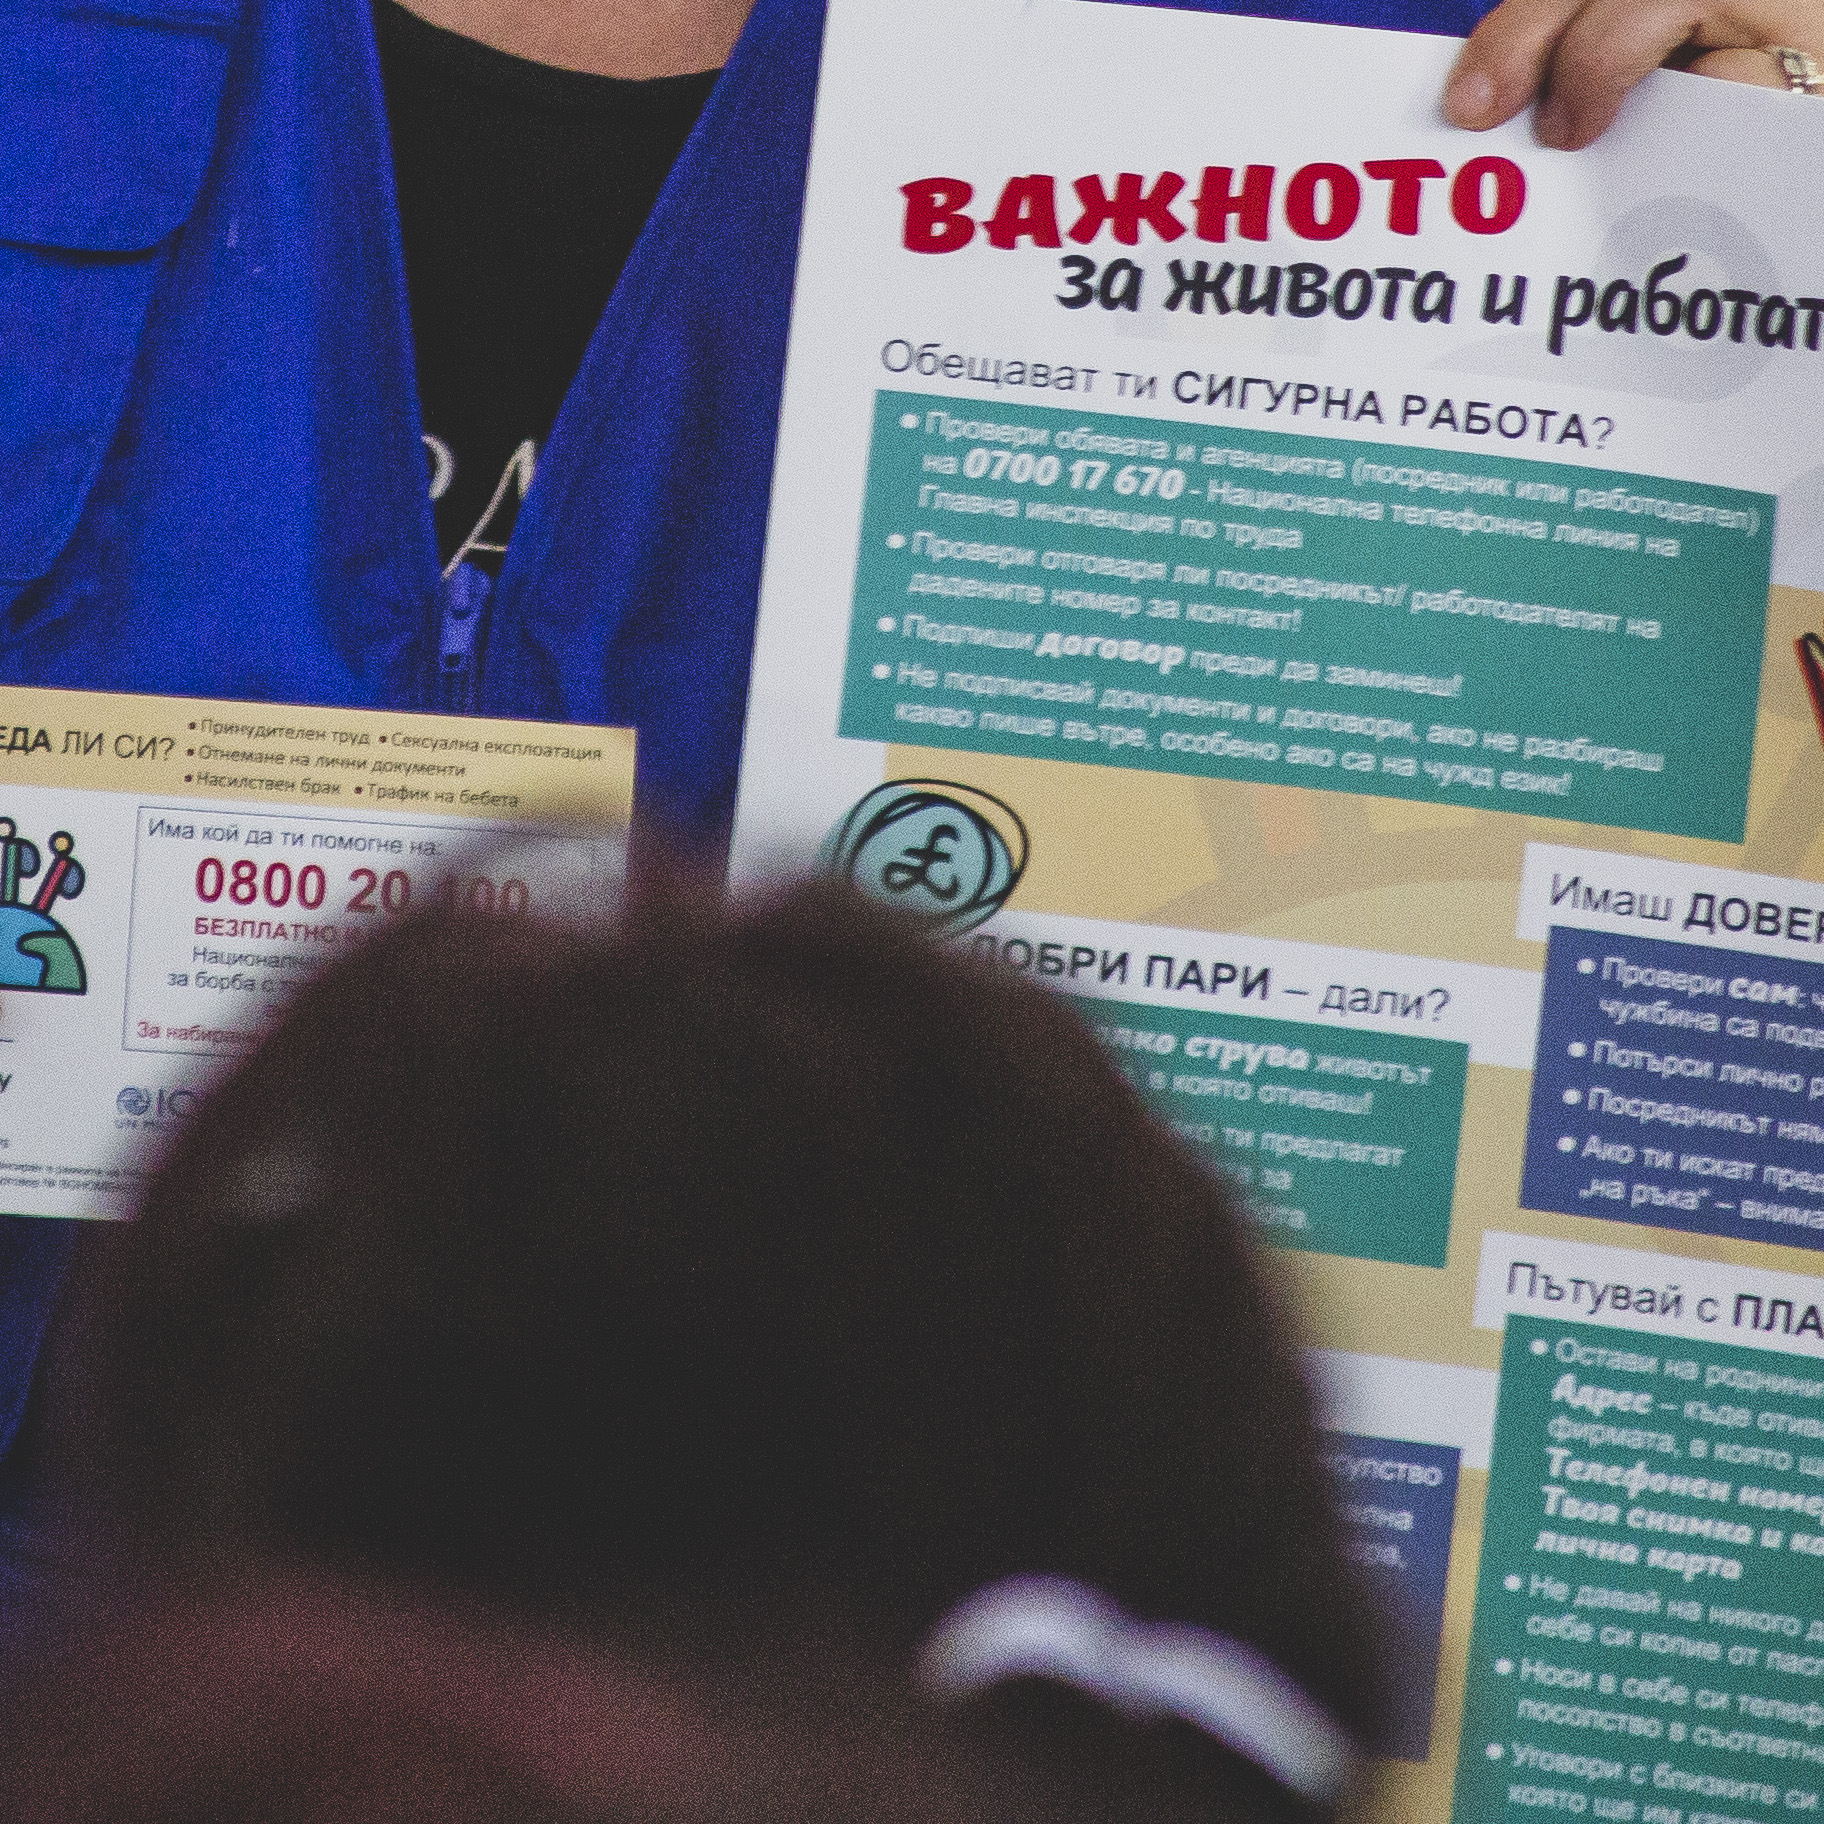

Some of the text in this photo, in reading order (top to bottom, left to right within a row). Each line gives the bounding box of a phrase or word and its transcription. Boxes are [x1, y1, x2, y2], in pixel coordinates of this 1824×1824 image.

[900, 155, 1526, 254] ВАЖНОТО
[1057, 254, 1142, 311] за
[1164, 259, 1456, 324] живота
[1480, 272, 1525, 327] и
[882, 338, 1613, 447] Обещават ти СИГУРНА РАБОТА?
[922, 446, 1680, 557] на 0700 17 670 Национална телефонна линия на
[925, 410, 1049, 447] Провери
[1054, 426, 1169, 459] обявата
[1201, 445, 1345, 478] агенцията
[1351, 457, 1509, 495] (посредник
[1515, 481, 1569, 503] или
[1574, 486, 1758, 535] работодател)
[918, 483, 1303, 550] Главна инспекция по труда
[907, 572, 1302, 630] дадените номер за контакт!
[912, 530, 1036, 568] Провери
[1040, 550, 1167, 582] отговаря
[1172, 564, 1210, 584] ли
[1626, 618, 1661, 639] на
[902, 614, 1462, 696] Подпиши договор преди да заминеш!
[62, 729, 104, 754] ЛИ
[114, 733, 175, 758] СИ?
[897, 662, 937, 687] Не
[944, 671, 1095, 703] подписвай
[1098, 688, 1251, 720] документи
[1280, 707, 1418, 742] договори,
[1426, 724, 1477, 747] ако
[1482, 731, 1518, 752] не
[1523, 736, 1663, 772] разбираш
[894, 703, 1571, 795] какво пише вътре, особено ако са на чужд език!
[459, 789, 521, 808] бебета
[195, 856, 326, 909] 0800
[346, 867, 410, 912] 20
[1550, 875, 1670, 921] Имаш
[194, 915, 339, 942] БЕЗПЛАТНО
[1144, 953, 1270, 999] ПАРИ
[1319, 984, 1449, 1016] дали?
[1602, 955, 1724, 996] Провери
[1727, 976, 1804, 1007] сам:
[1599, 999, 1720, 1032] чужбина
[1725, 1016, 1759, 1038] са
[1593, 1038, 1713, 1078] Потърси
[1718, 1063, 1804, 1092] лично
[1588, 1085, 1771, 1134] Посредникът
[1582, 1134, 1635, 1164] Ако
[1642, 1147, 1673, 1168] ти
[1679, 1154, 1756, 1179] искат
[1507, 1260, 1682, 1315] Пътувай
[1696, 1297, 1717, 1323] с
